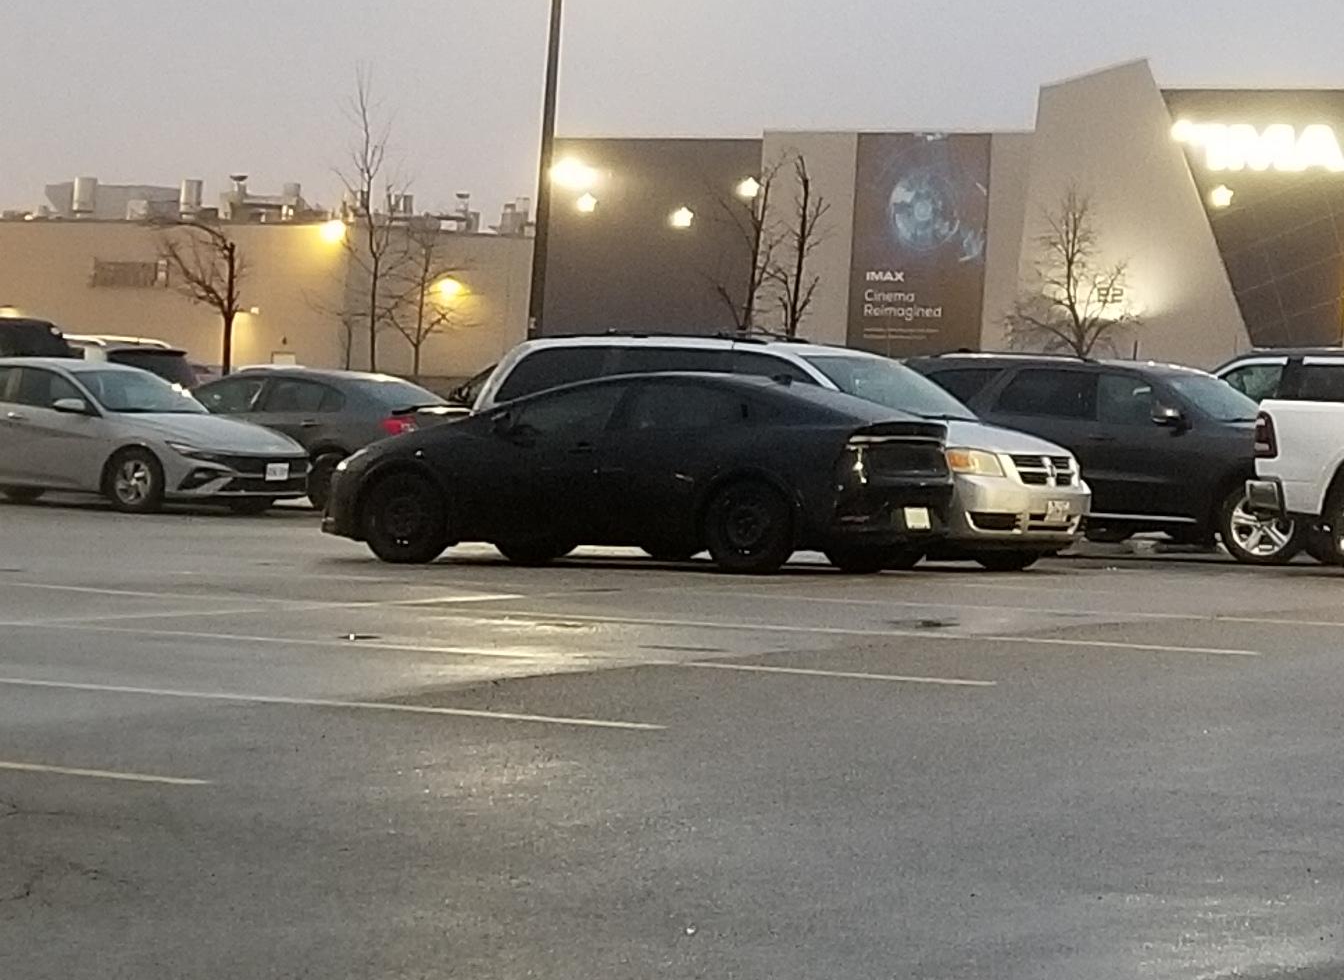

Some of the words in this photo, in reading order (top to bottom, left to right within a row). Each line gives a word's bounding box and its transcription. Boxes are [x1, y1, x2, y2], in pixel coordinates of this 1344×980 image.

[865, 271, 905, 282] IMAX
[864, 288, 915, 303] Cinema
[863, 303, 943, 322] Reimagined
